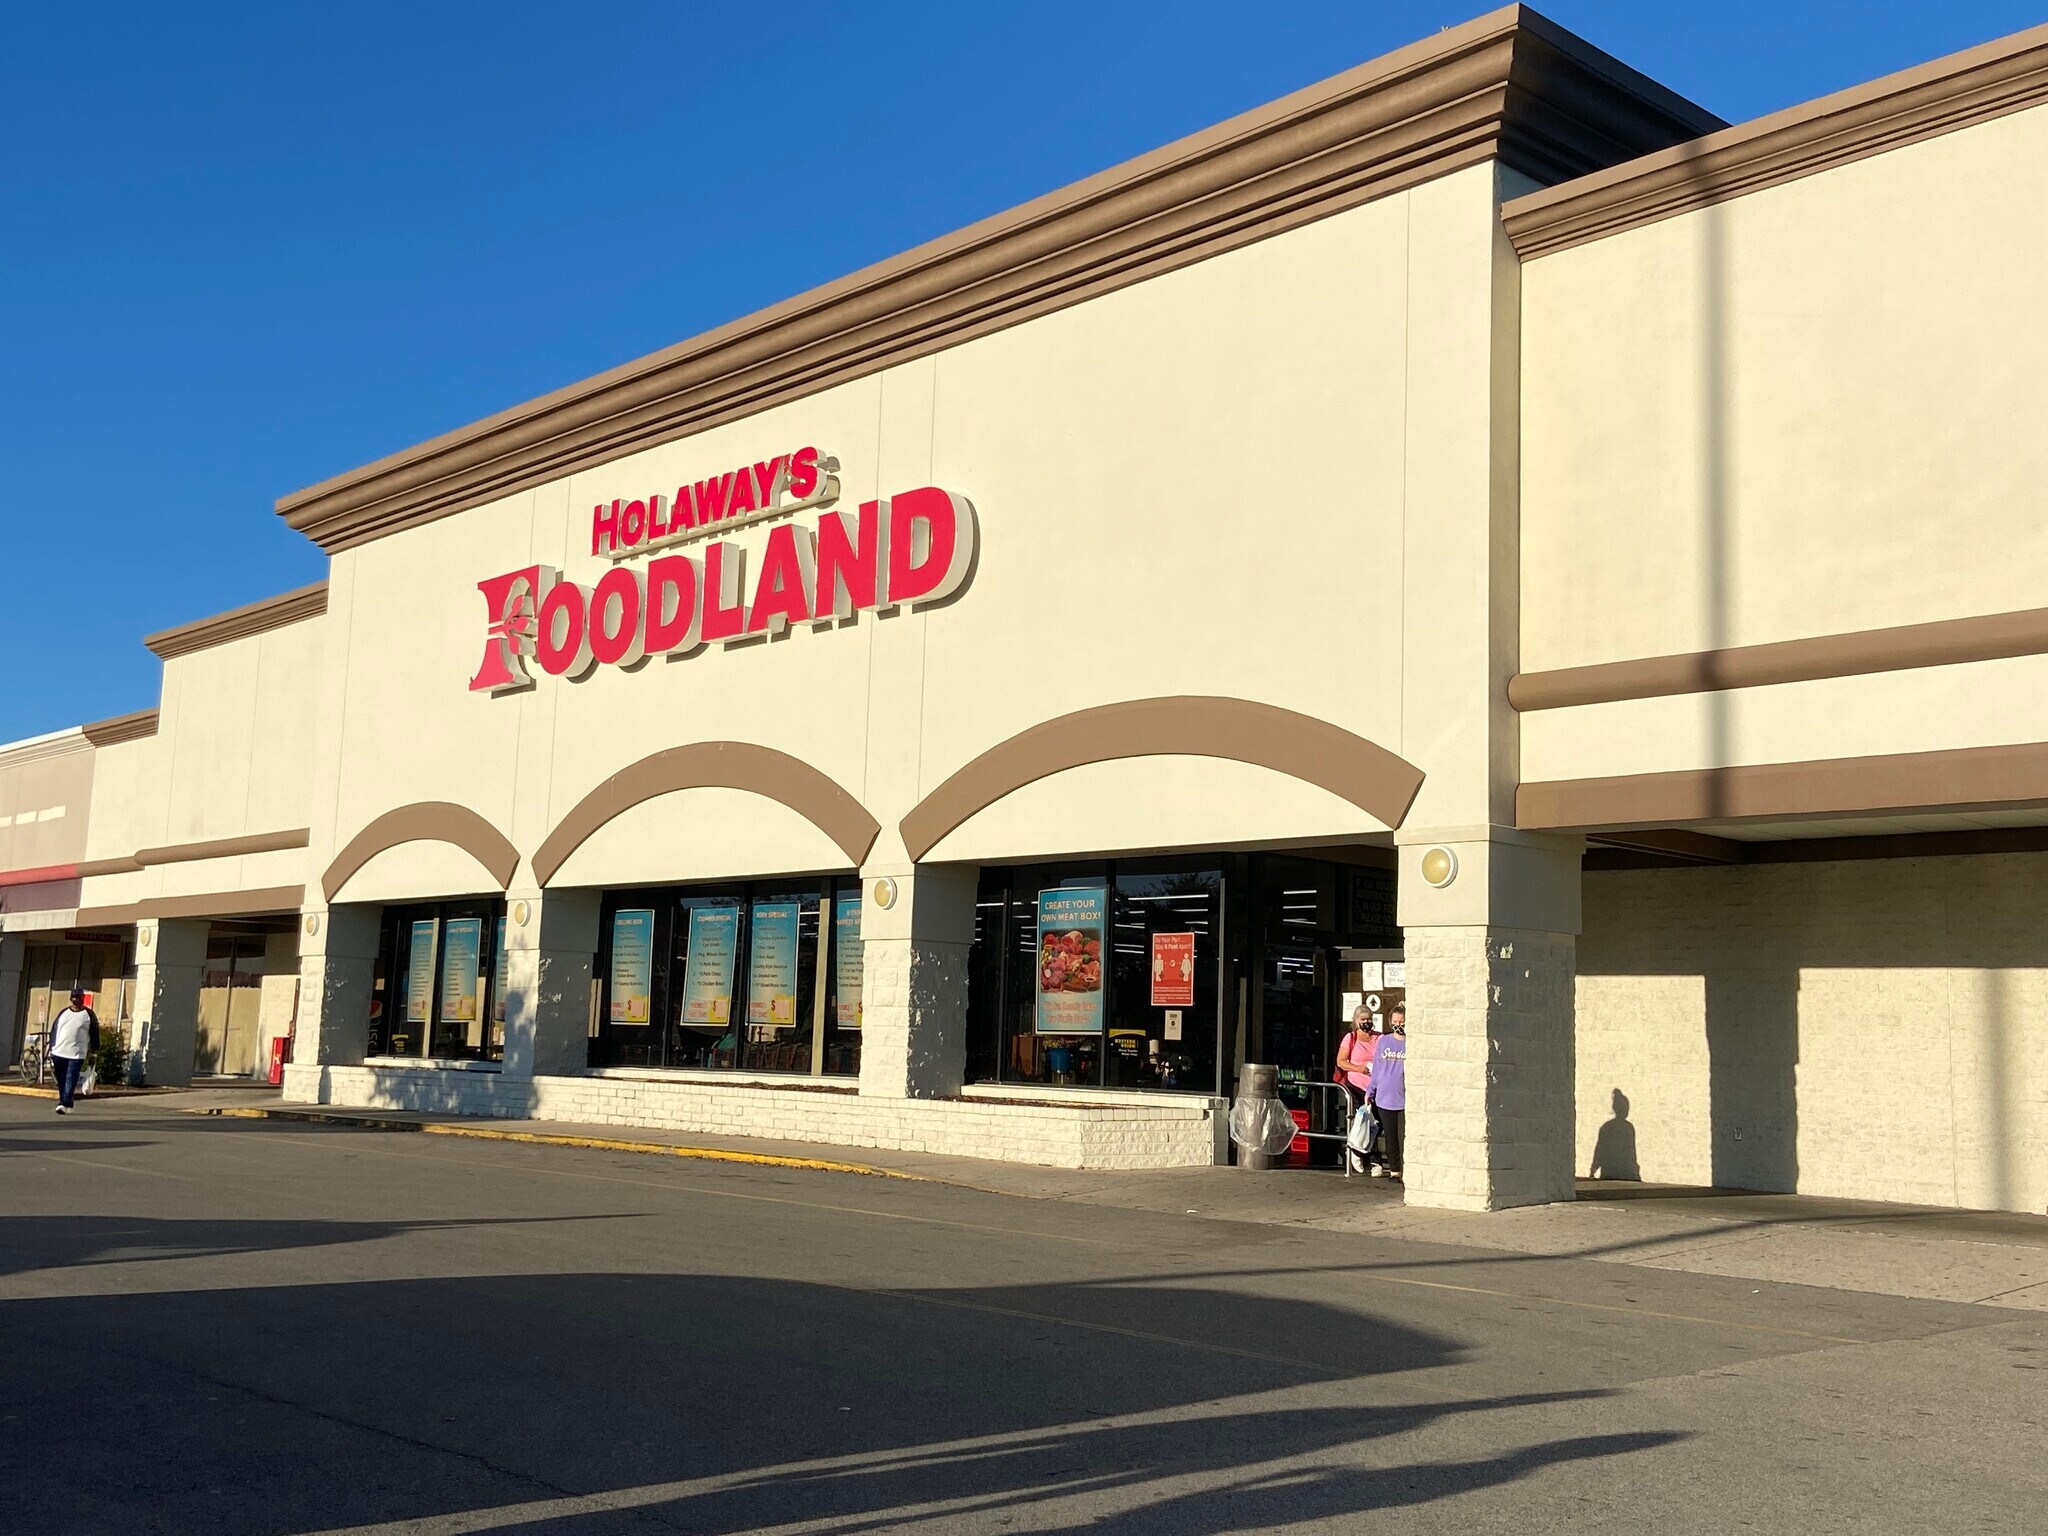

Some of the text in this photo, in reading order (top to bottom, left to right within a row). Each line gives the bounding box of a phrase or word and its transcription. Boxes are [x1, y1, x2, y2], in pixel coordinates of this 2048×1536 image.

[591, 446, 824, 557] HOLAWAY'S
[469, 486, 968, 693] FOODLAND
[1045, 899, 1096, 910] CREATE YOUR
[1041, 911, 1101, 923] OWN MEAT BOX!
[1155, 943, 1164, 951] Stay
